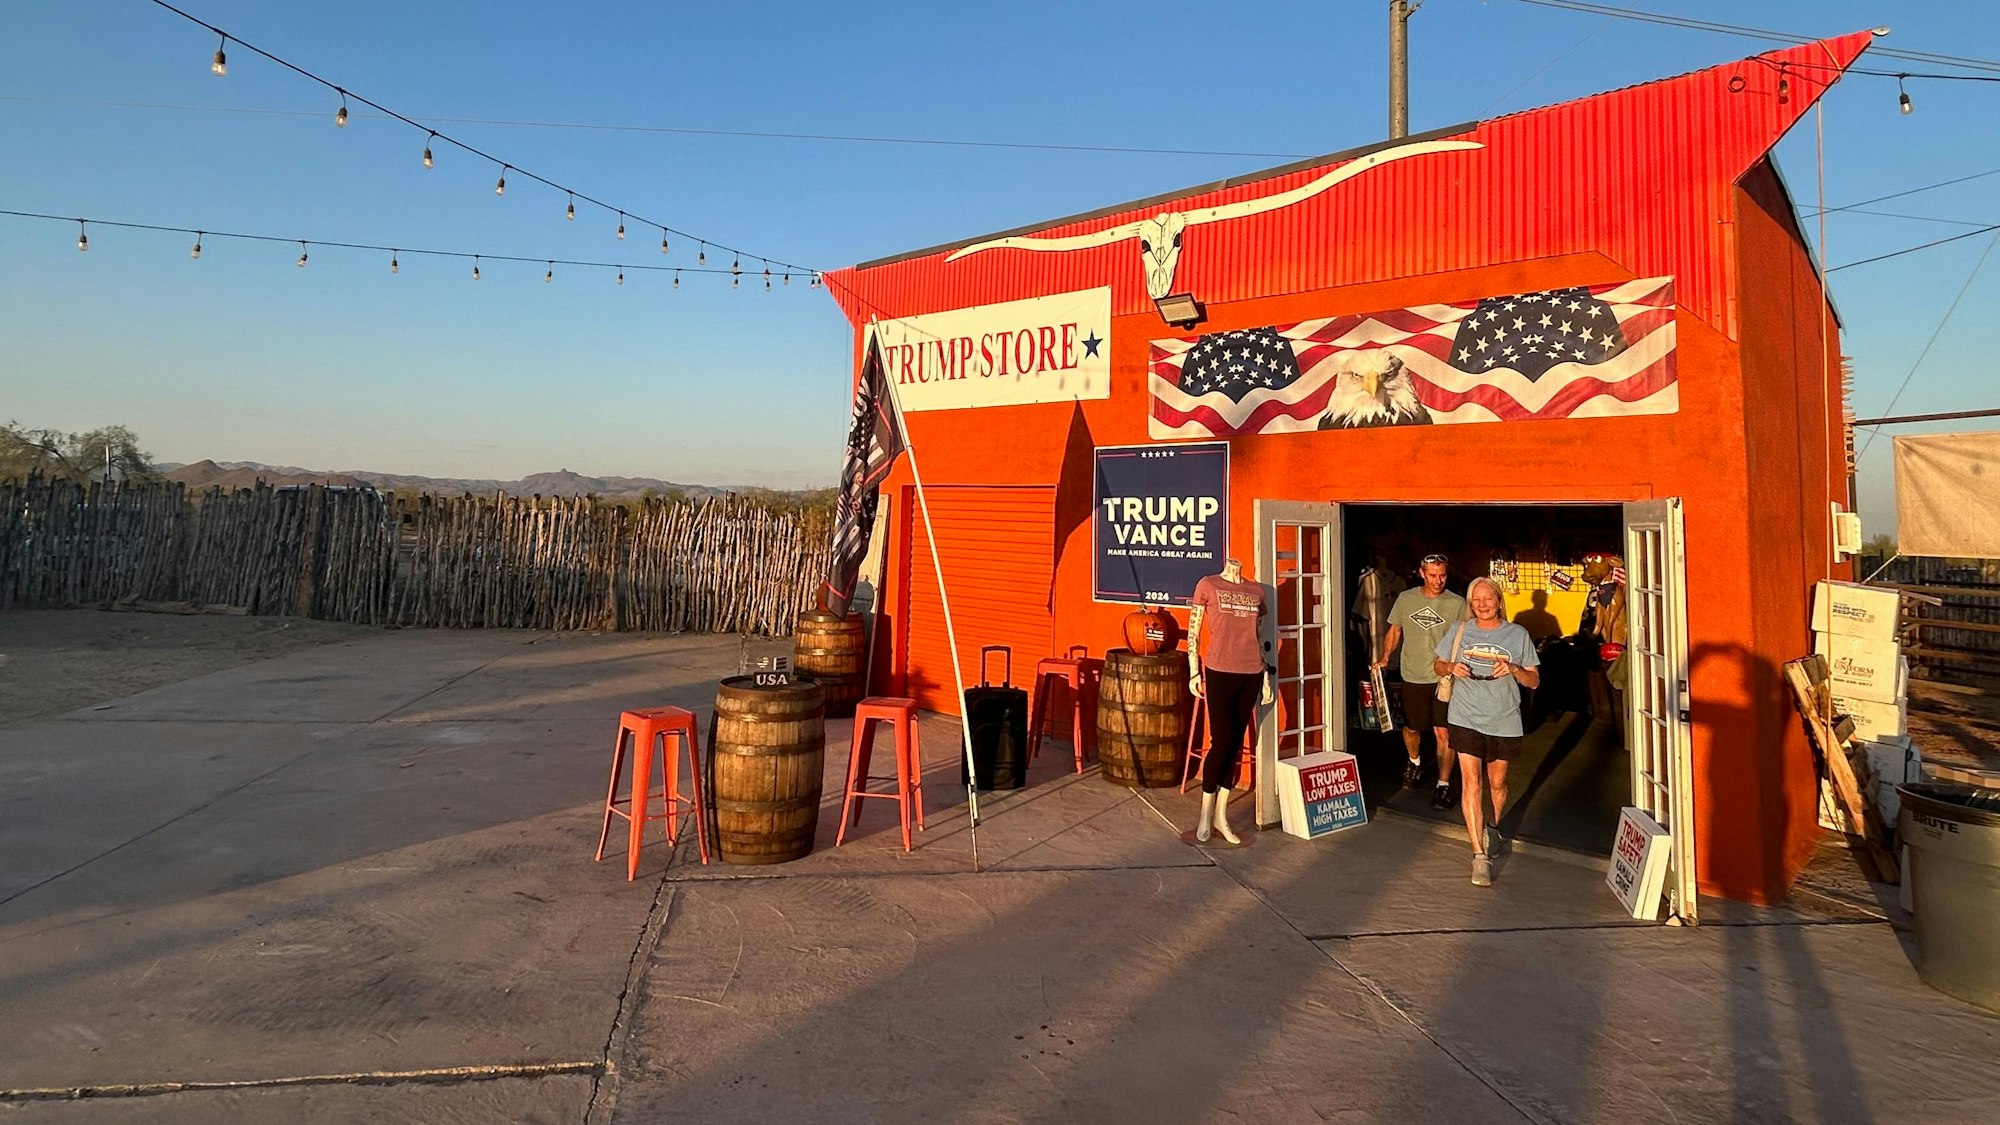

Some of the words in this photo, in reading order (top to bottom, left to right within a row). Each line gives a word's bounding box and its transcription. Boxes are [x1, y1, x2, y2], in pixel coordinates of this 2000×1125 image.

[886, 335, 975, 385] TRUMP
[979, 322, 1079, 379] STORE
[1102, 496, 1219, 523] TRUMP
[1113, 523, 1206, 547] VANCE
[1107, 548, 1126, 556] MAKE
[1128, 549, 1160, 558] AMERICA
[1161, 550, 1185, 559] GREAT
[1186, 551, 1213, 560] AGAIN!
[1145, 590, 1169, 601] 2024
[1832, 608, 1867, 618] RESPECT
[756, 674, 788, 686] USA
[1309, 767, 1348, 789] TRUMP
[1306, 787, 1326, 802] LOW
[1327, 780, 1356, 797] TAXES
[1312, 811, 1333, 827] HIGH
[1333, 806, 1359, 821] TAXES
[1317, 797, 1351, 815] KAMALA
[1621, 819, 1646, 852] TRUMP
[1617, 835, 1643, 870] SAFETY
